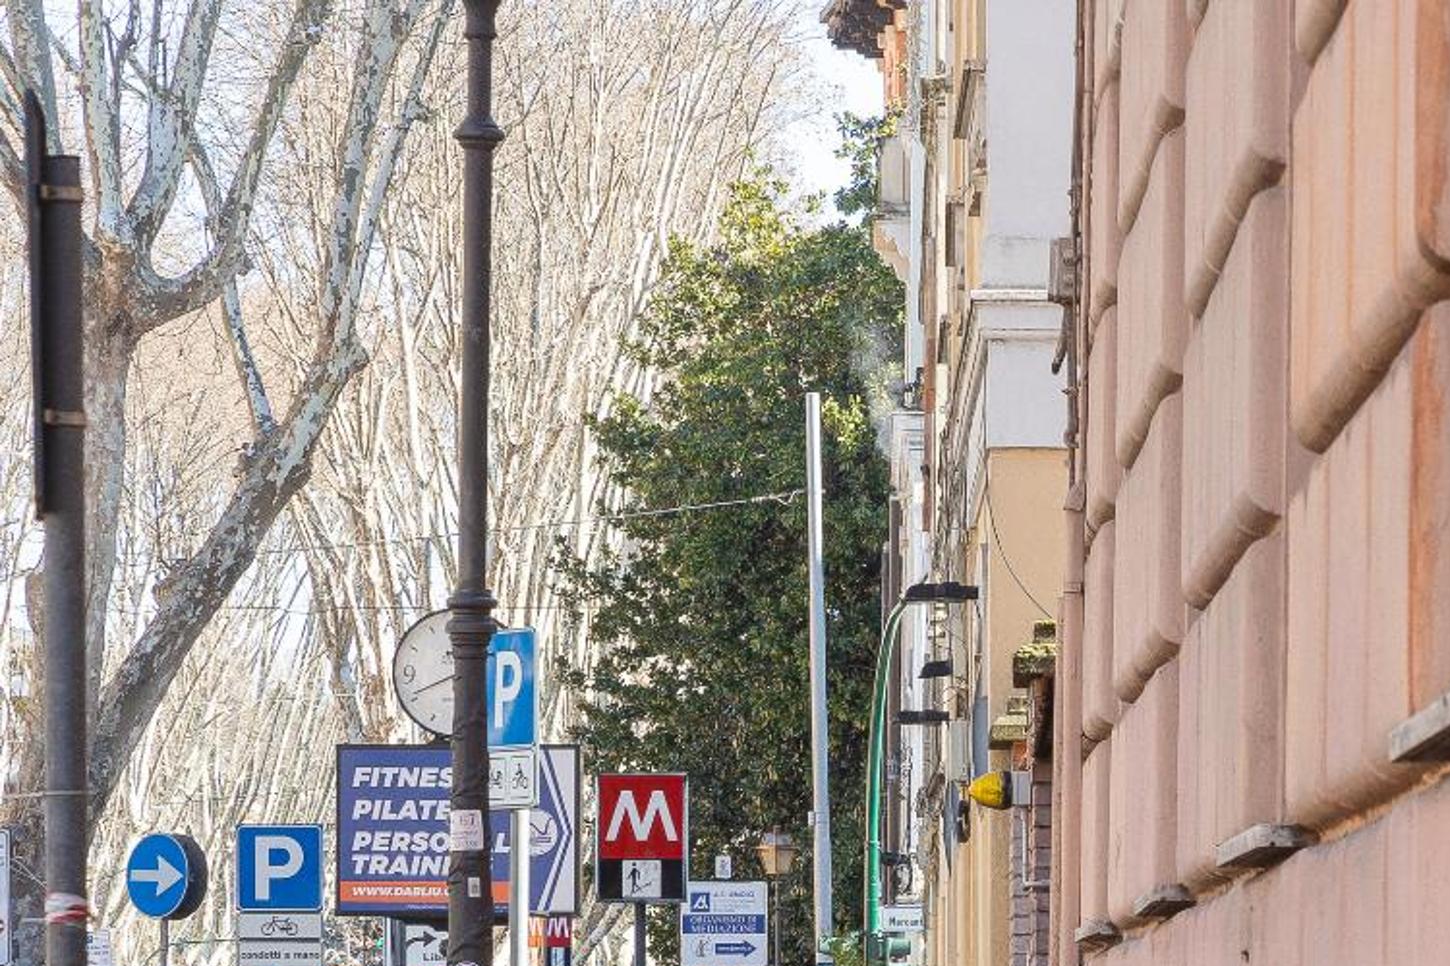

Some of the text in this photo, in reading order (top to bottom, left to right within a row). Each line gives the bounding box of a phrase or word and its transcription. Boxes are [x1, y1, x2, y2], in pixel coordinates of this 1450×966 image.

[494, 651, 522, 728] P
[605, 790, 678, 841] M
[255, 836, 304, 900] P
[241, 951, 281, 960] condotti
[423, 953, 446, 961] Lib
